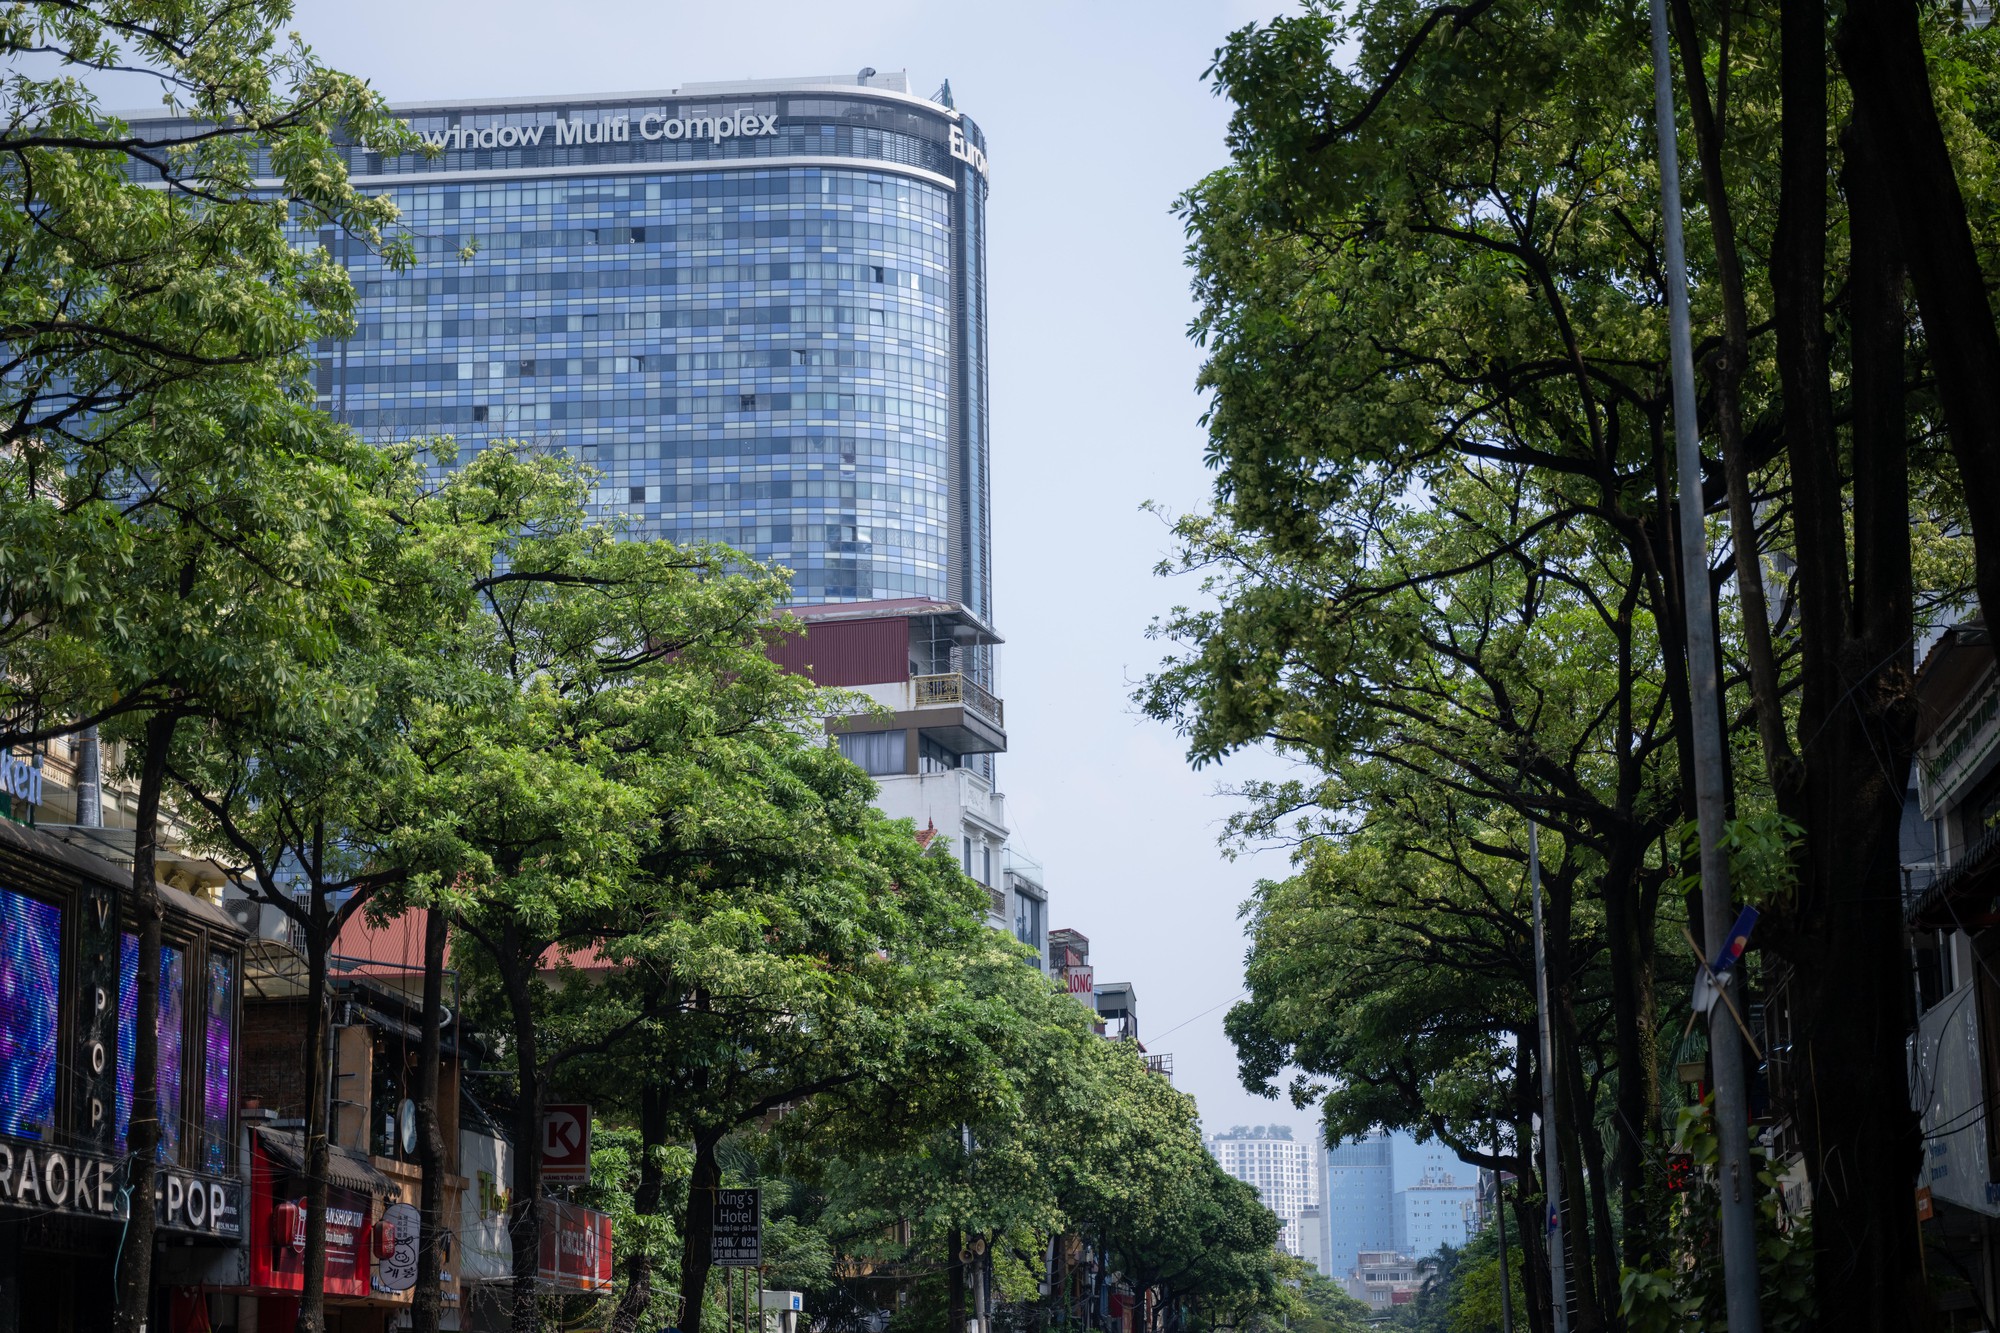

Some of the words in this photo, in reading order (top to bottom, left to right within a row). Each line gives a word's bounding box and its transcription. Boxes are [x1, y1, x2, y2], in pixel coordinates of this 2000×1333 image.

[361, 121, 545, 154] window
[555, 115, 629, 146] Multi
[639, 110, 778, 144] Complex
[548, 1121, 578, 1150] K
[719, 1191, 754, 1209] King's
[720, 1209, 752, 1223] Hotel
[741, 1237, 757, 1247] 02h
